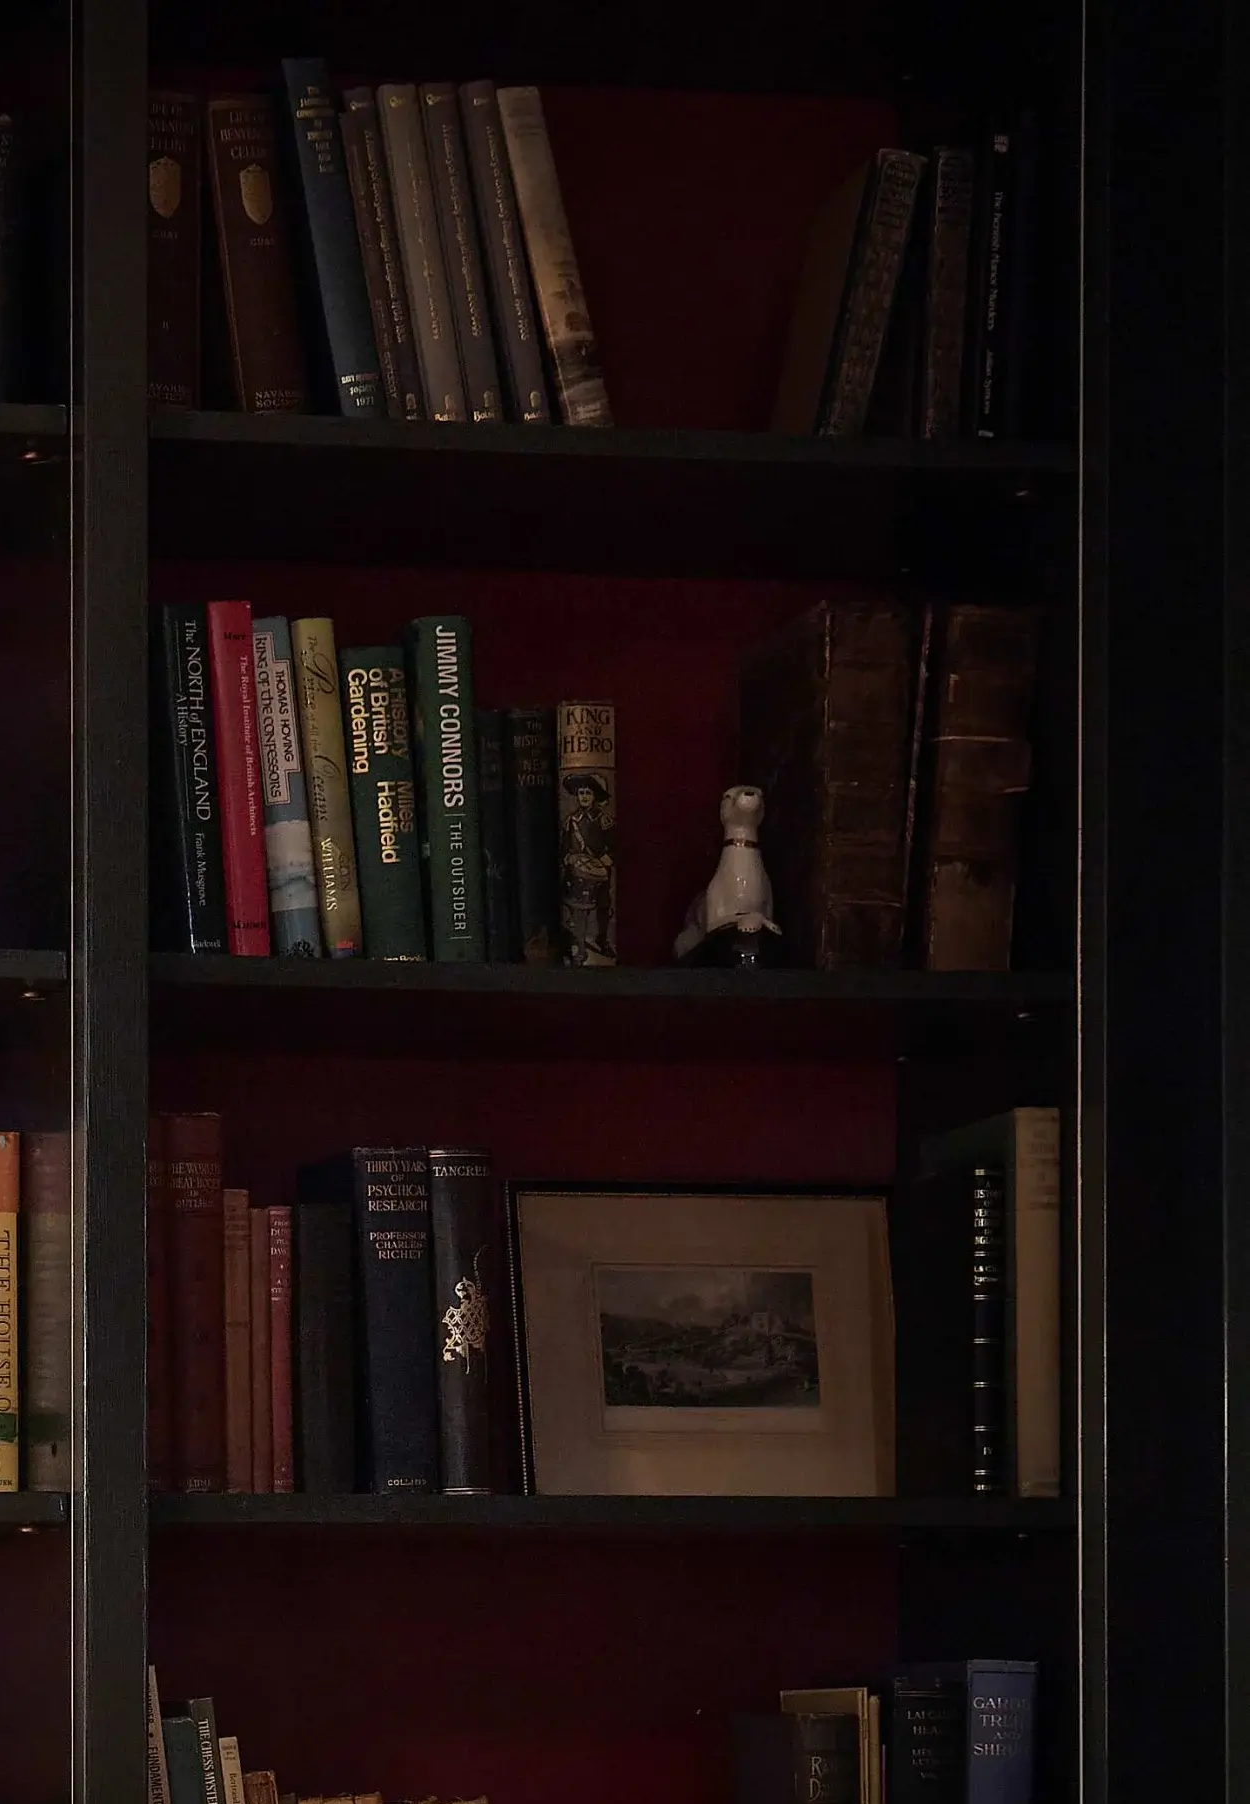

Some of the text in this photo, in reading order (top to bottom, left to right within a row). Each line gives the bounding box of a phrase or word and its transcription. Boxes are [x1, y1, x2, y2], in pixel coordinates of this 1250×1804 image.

[240, 655, 249, 674] The
[239, 676, 251, 702] Royal
[175, 692, 190, 747] A History
[185, 619, 211, 821] The NORTH of ENGLAND
[241, 705, 253, 743] Institute
[255, 636, 268, 669] KING
[263, 716, 282, 798] CONFESSORS
[275, 670, 294, 763] THOMAS HOVING
[347, 668, 371, 775] Gardening
[368, 667, 391, 756] of British
[389, 667, 411, 760] A History
[435, 625, 465, 809] JIMMY CONNORS
[566, 707, 610, 725] KING
[563, 736, 613, 754] HERO
[575, 727, 602, 736] AND
[247, 789, 257, 838] Architects
[376, 780, 402, 865] Hadfield
[396, 779, 415, 833] Miles
[195, 832, 205, 861] Frank
[320, 837, 337, 911] WILLIAMS
[450, 821, 467, 931] THE OUTSIDER
[364, 1160, 399, 1173] THIRTY
[367, 1184, 428, 1197] PSYCHICAL
[368, 1200, 428, 1212] RESEARCH
[370, 1231, 426, 1241] PROFESSOR
[376, 1240, 423, 1250] CHARLES
[378, 1250, 423, 1260] RICHET
[198, 1718, 210, 1741] THE
[200, 1741, 215, 1771] CHESS
